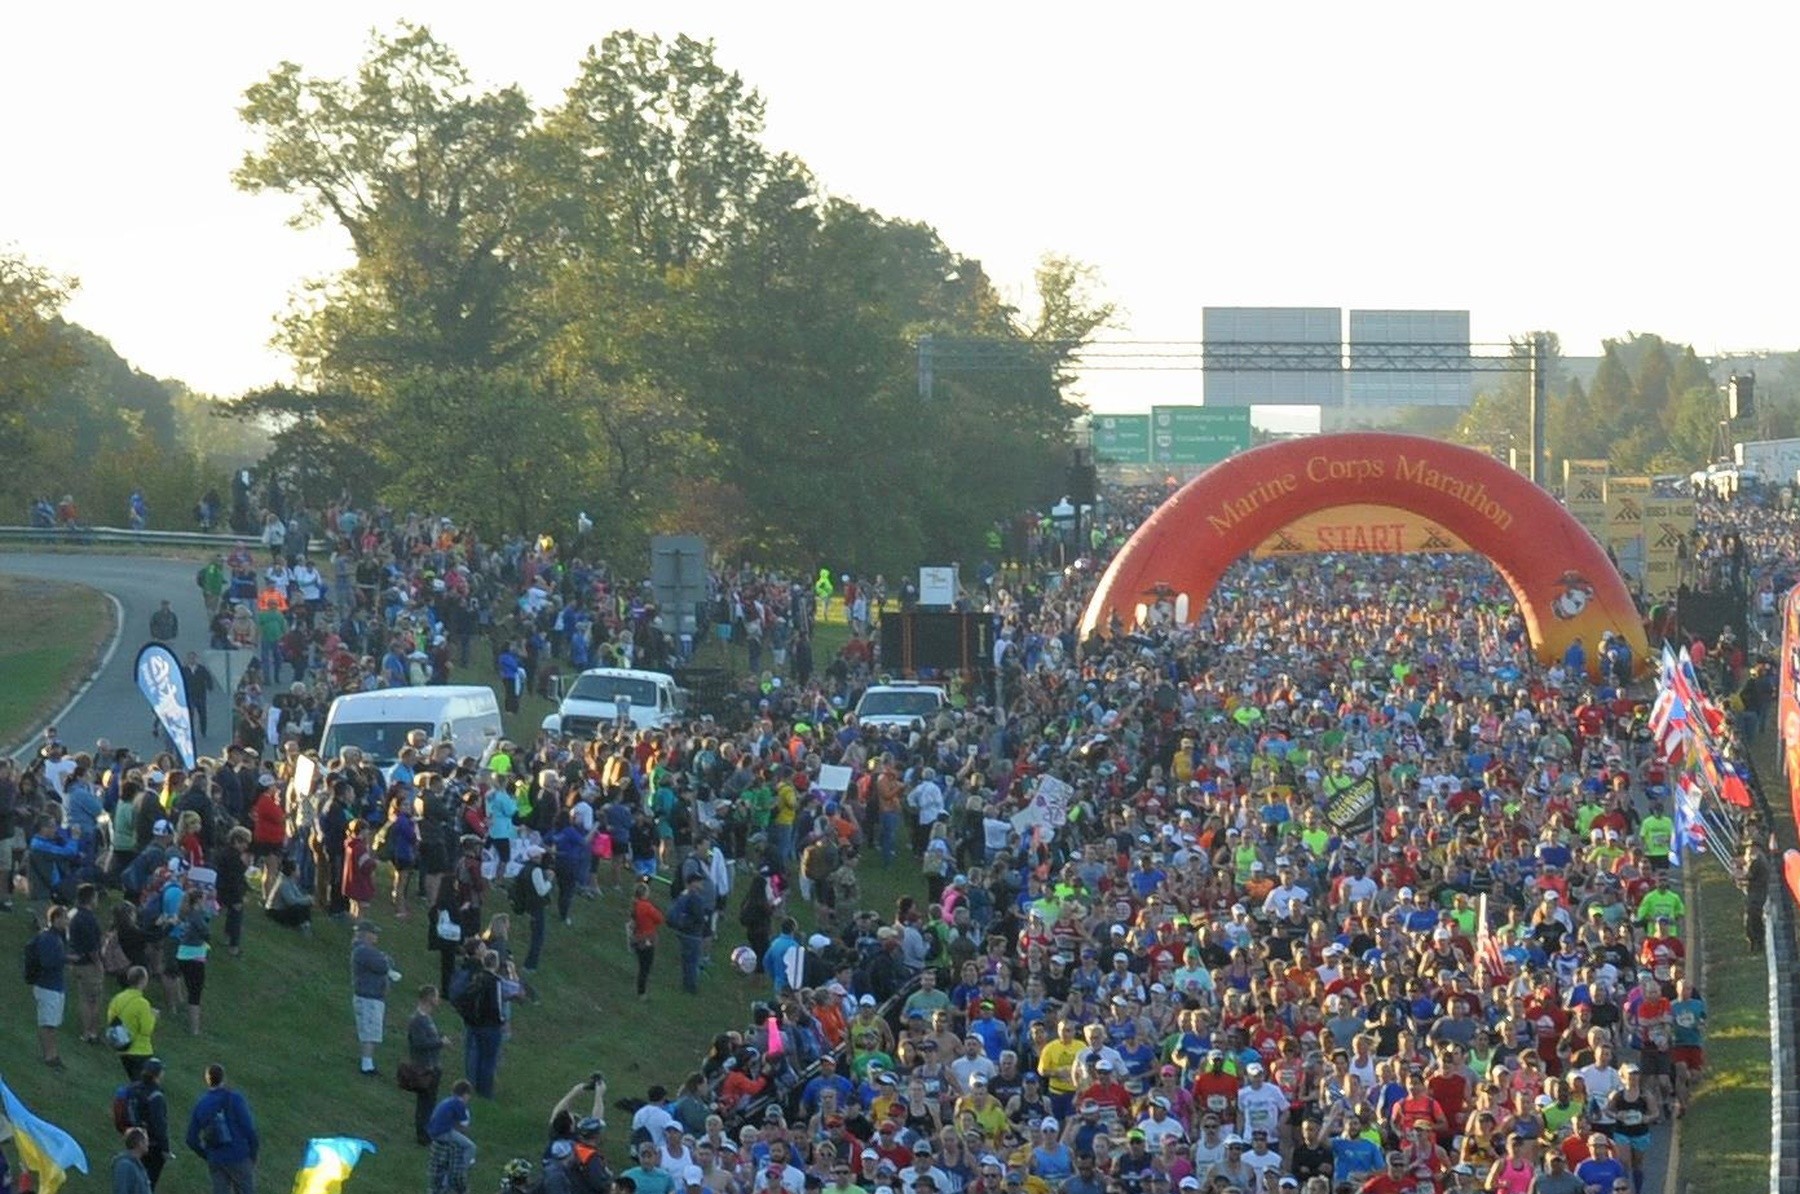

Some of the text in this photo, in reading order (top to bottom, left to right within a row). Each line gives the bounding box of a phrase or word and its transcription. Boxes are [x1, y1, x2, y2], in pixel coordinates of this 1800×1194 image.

[1206, 471, 1297, 537] Marine
[1306, 455, 1384, 484] Corps
[1395, 454, 1515, 532] Marathon
[1316, 523, 1406, 552] START
